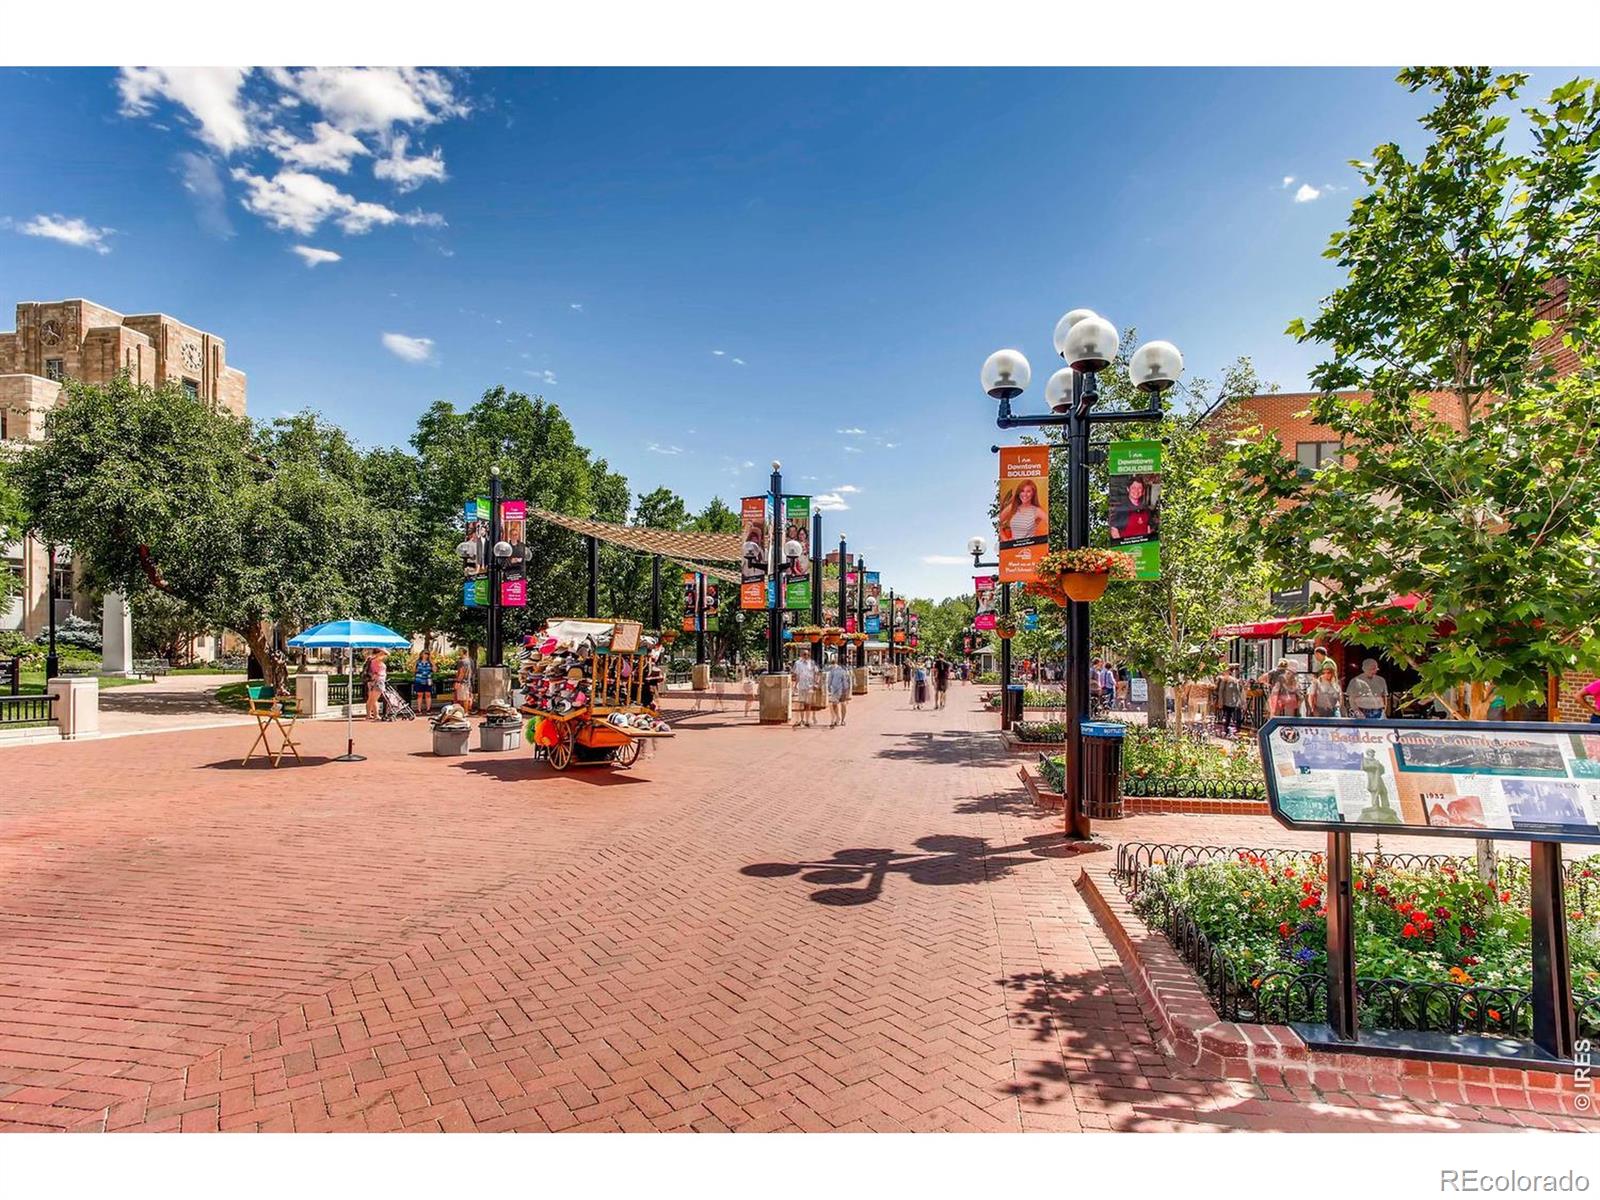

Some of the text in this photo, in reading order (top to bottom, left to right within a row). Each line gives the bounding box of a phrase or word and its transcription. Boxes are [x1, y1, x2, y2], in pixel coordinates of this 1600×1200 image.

[1007, 469, 1041, 477] BOULDER
[1117, 465, 1153, 473] BOULDER
[1330, 731, 1384, 744] Boulder
[1386, 732, 1438, 747] County
[1425, 792, 1445, 800] 1932
